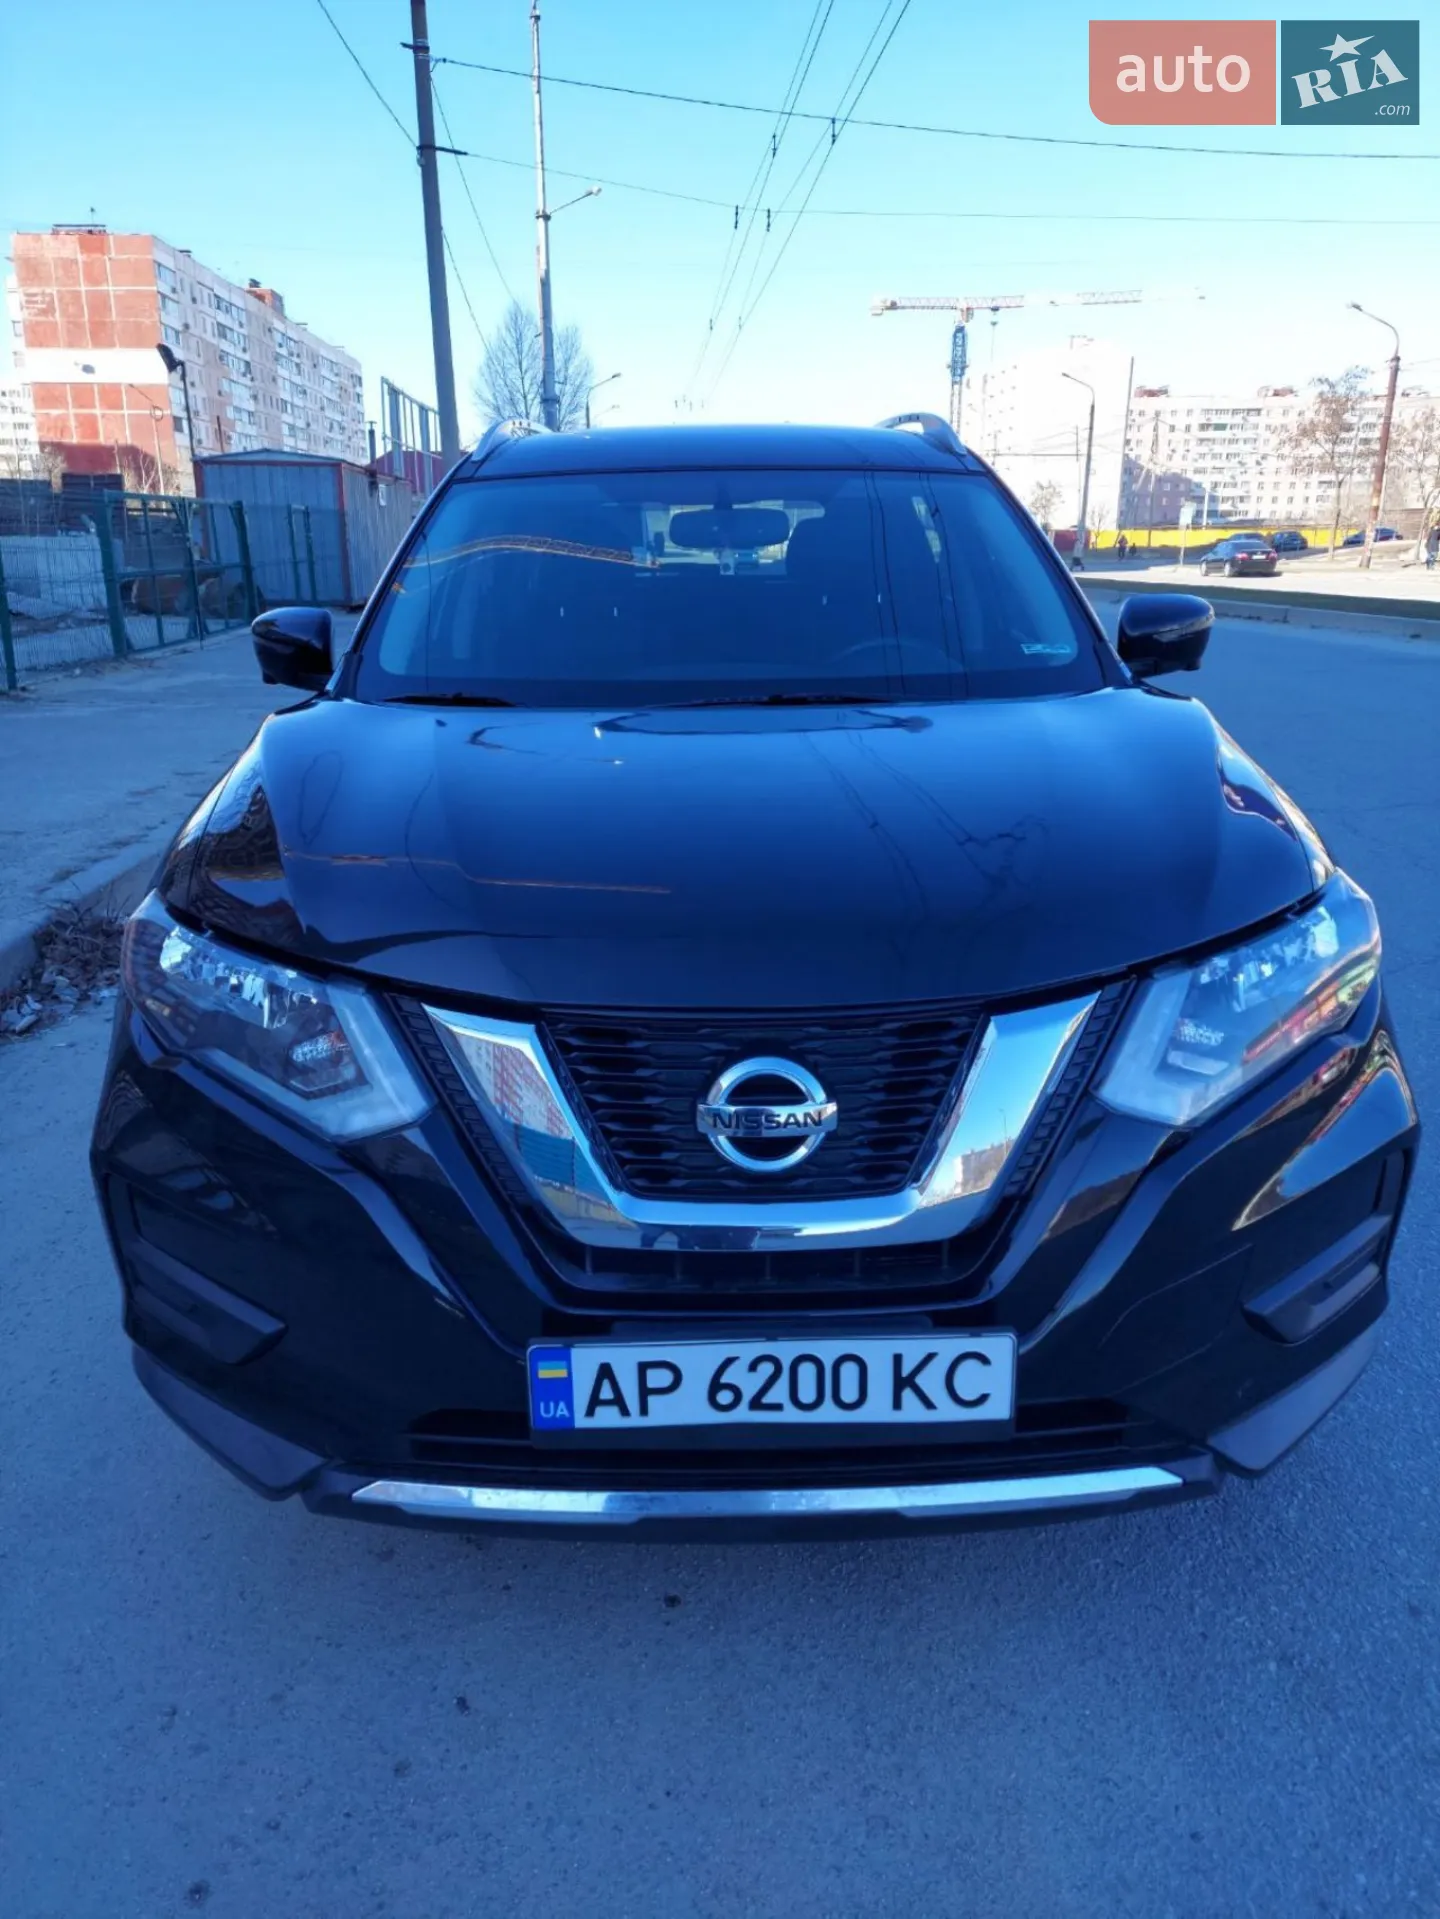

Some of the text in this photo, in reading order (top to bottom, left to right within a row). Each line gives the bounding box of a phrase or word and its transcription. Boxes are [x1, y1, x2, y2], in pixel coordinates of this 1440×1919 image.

[712, 1111, 823, 1130] NISSAN
[583, 1350, 993, 1418] AP 6200 KC
[539, 1400, 571, 1418] UA
